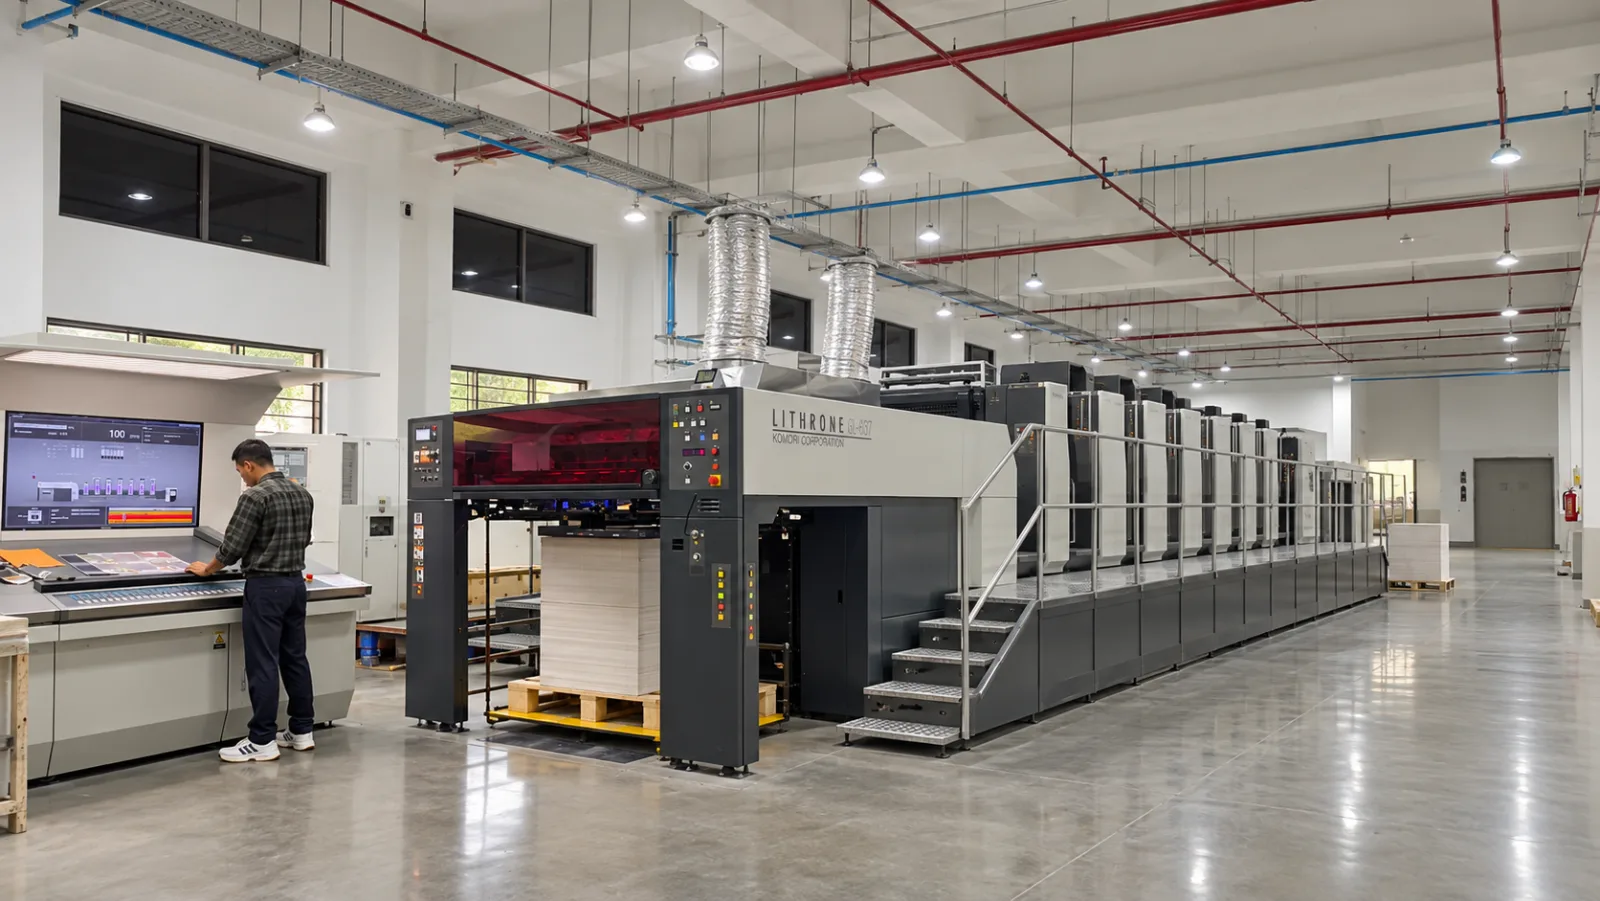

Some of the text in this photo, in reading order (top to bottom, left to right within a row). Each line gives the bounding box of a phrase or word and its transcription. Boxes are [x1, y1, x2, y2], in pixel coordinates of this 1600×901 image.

[772, 408, 844, 433] LITHRONE
[109, 429, 125, 438] 100
[772, 433, 844, 447] KOMORI CORPORATION
